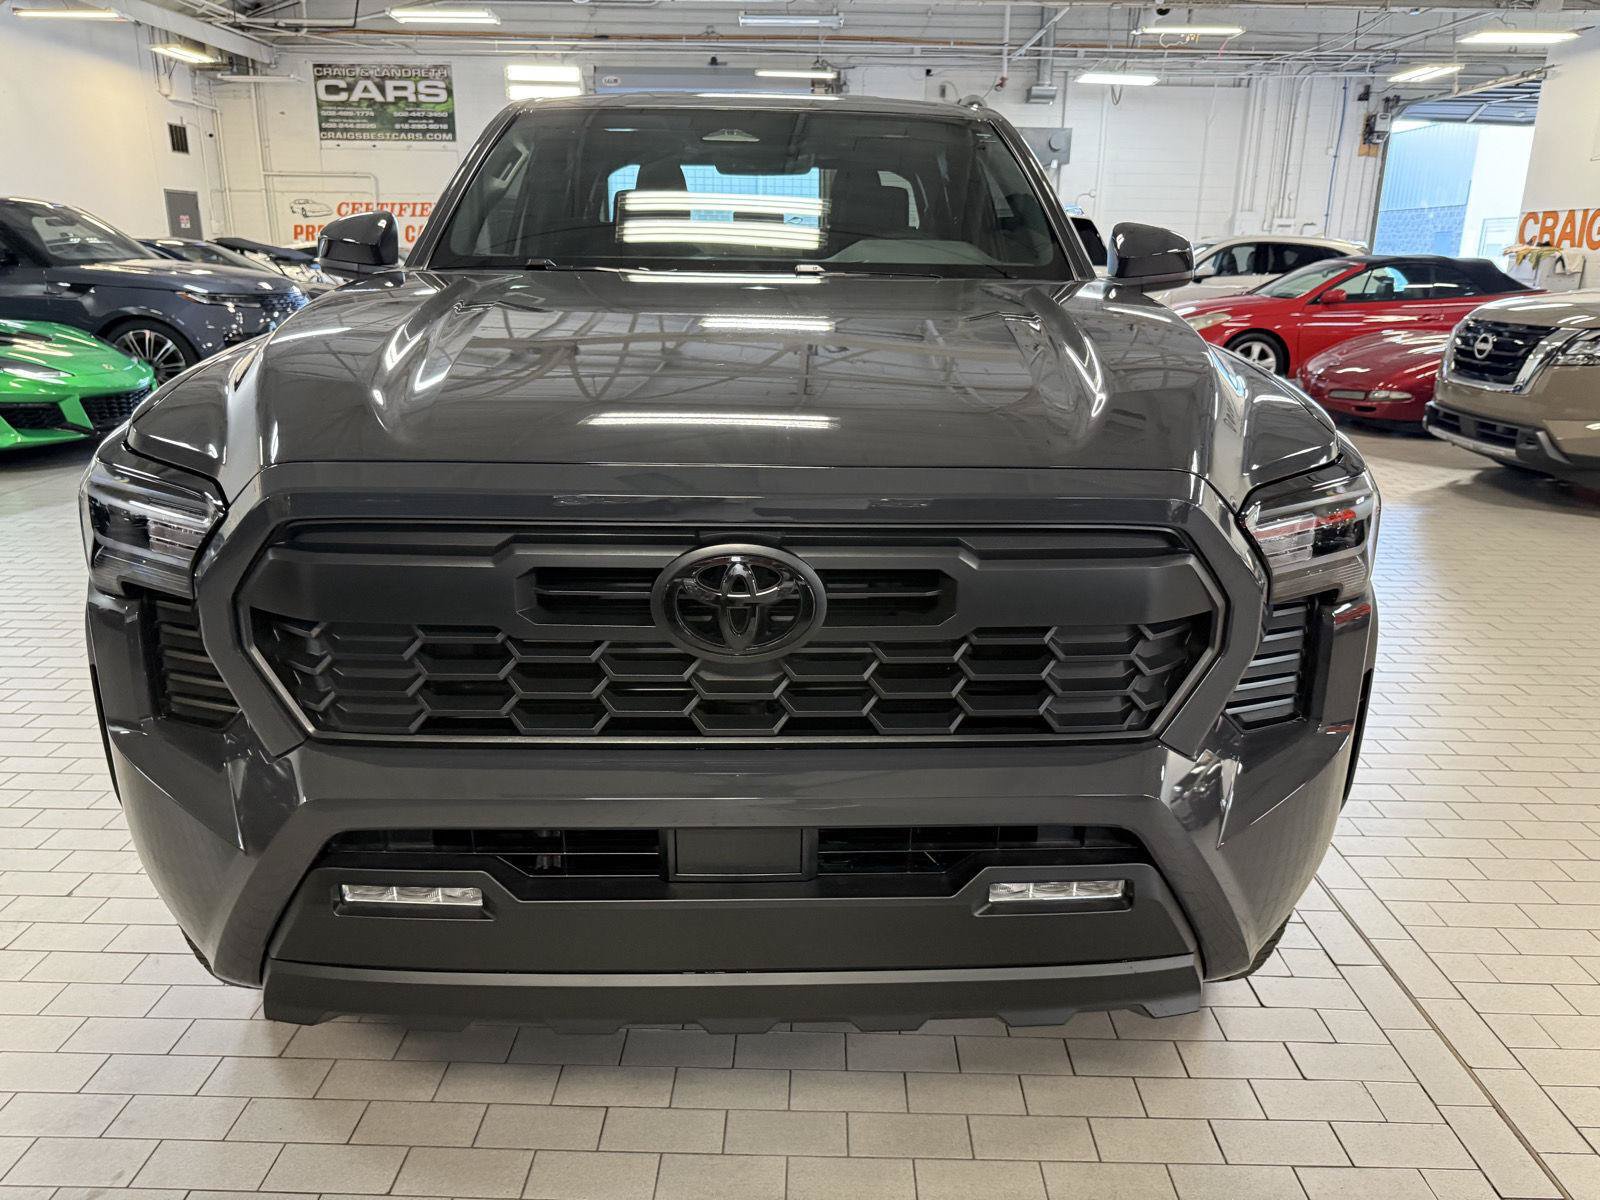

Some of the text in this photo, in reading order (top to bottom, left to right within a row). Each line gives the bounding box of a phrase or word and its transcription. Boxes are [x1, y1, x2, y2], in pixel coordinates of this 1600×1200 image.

[314, 67, 448, 78] CRAIG & LANDRETH
[316, 79, 448, 103] CARS
[320, 132, 453, 141] CRAIGSBESTCARS.COM
[336, 201, 434, 218] CERTIFIE
[1518, 208, 1600, 251] CRAIG
